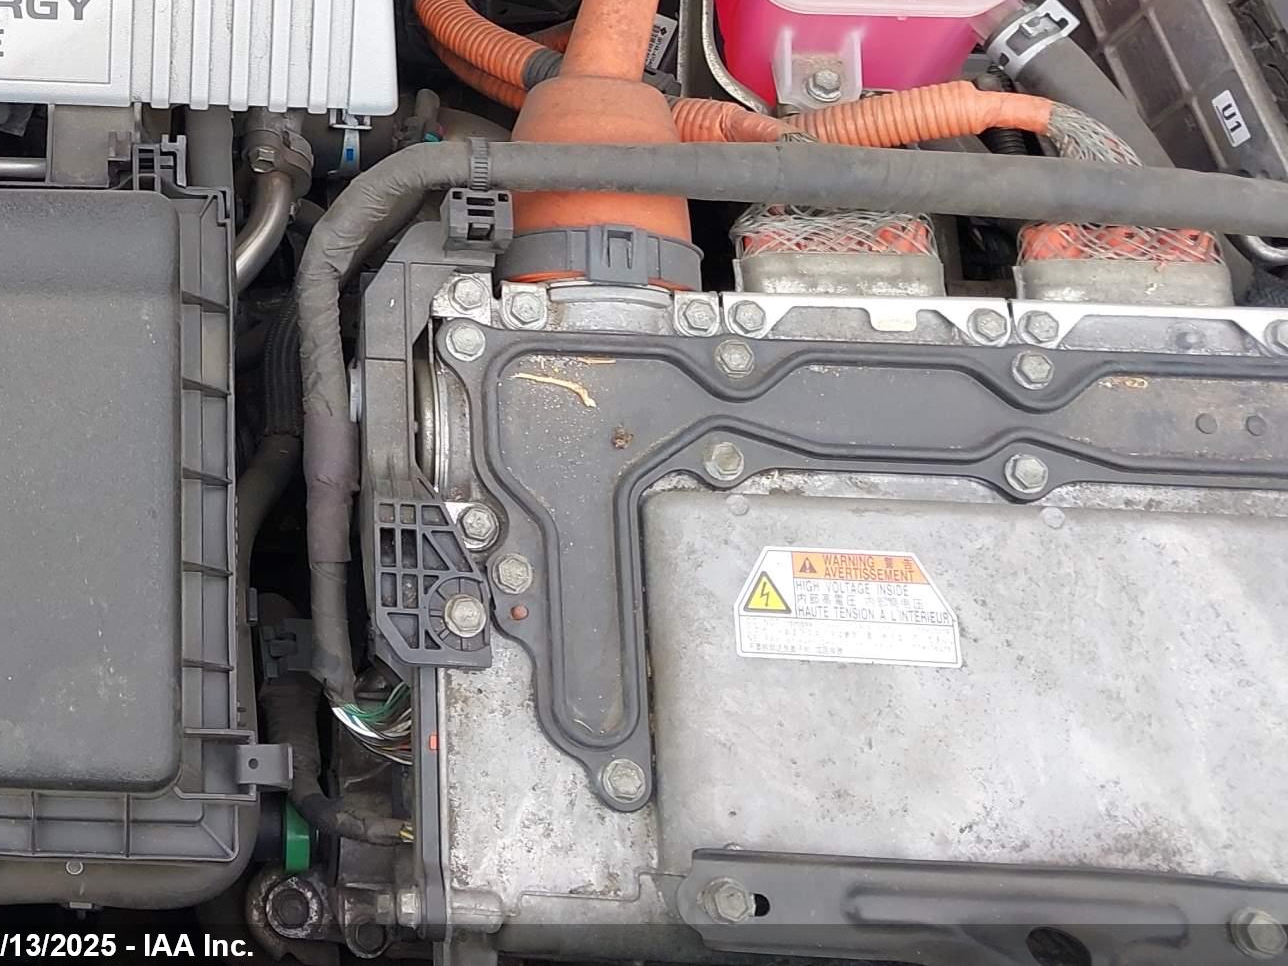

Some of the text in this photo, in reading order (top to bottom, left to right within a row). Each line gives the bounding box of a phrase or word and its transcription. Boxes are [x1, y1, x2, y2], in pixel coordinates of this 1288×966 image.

[1221, 103, 1242, 133] U1
[823, 554, 875, 568] WARNING
[823, 566, 915, 582] AVERTISSEMENT
[796, 581, 909, 597] HIGH VOLTAGE INSIDE
[798, 606, 829, 618] HAUTE
[833, 607, 875, 620] TENSION
